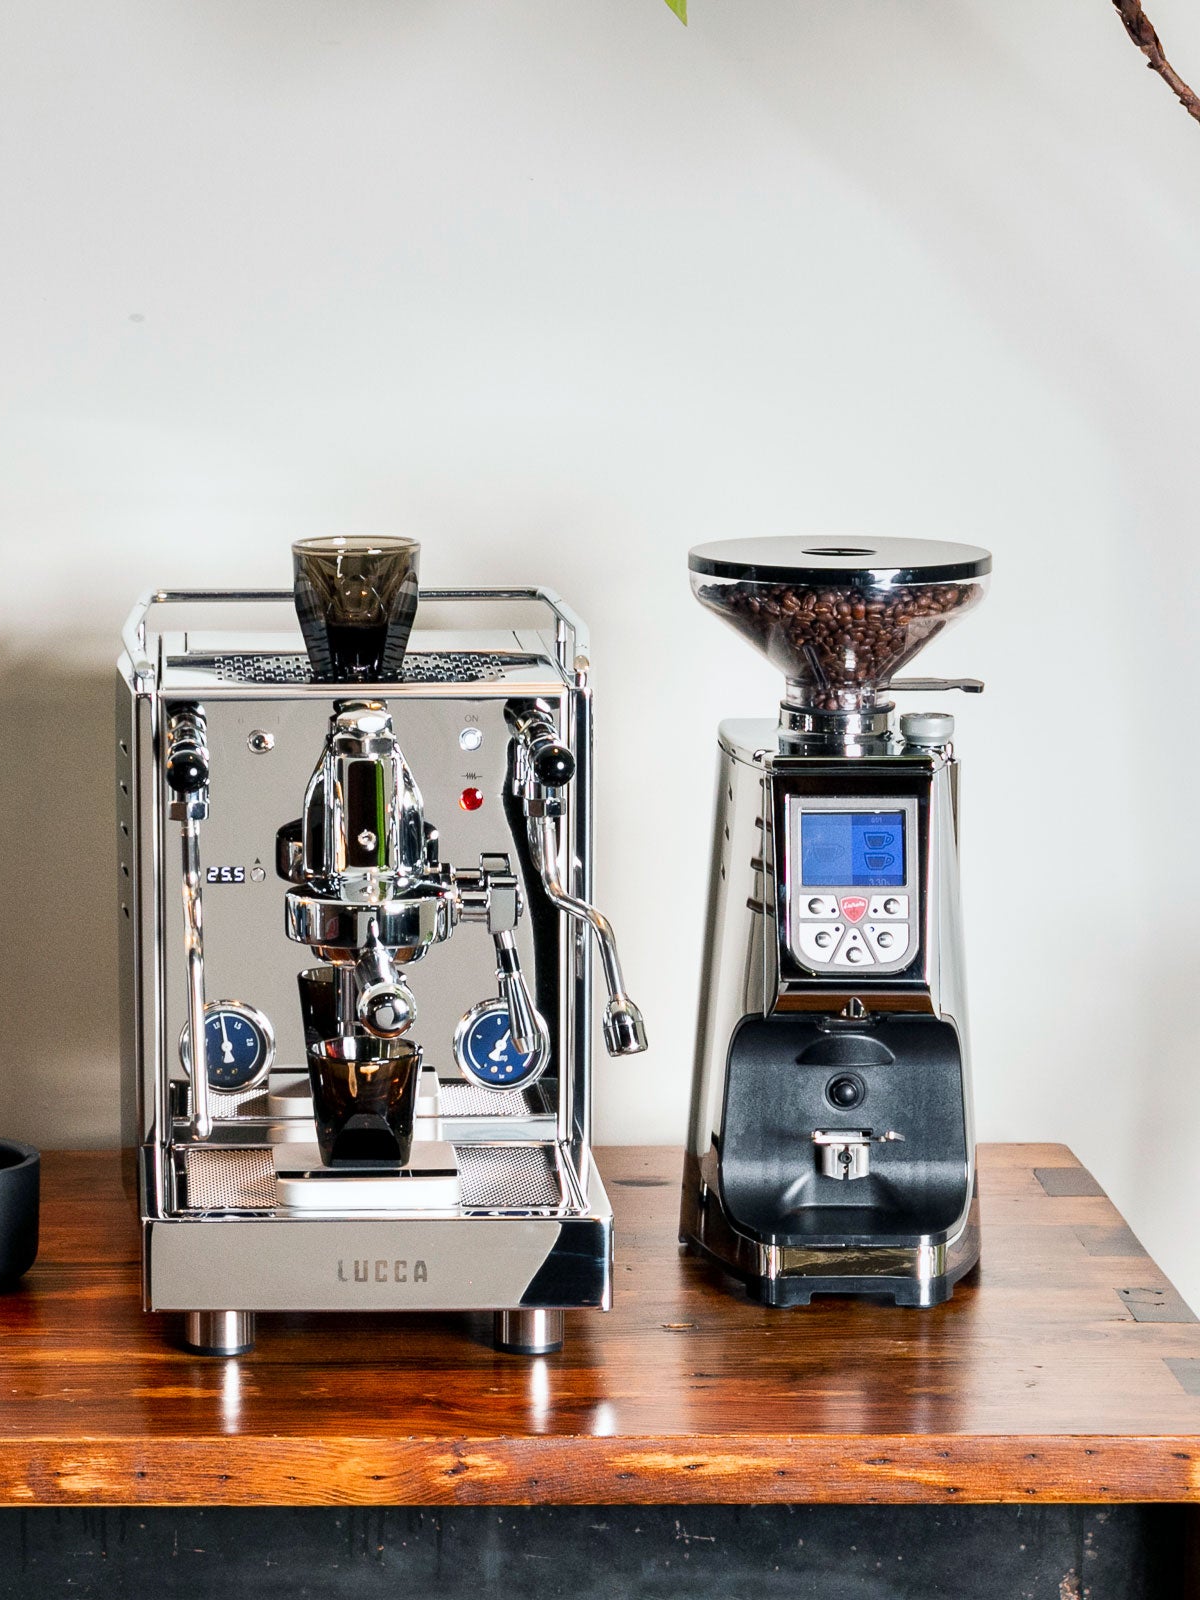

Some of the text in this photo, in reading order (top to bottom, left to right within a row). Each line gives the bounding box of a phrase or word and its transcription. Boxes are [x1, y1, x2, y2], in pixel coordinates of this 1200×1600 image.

[464, 714, 479, 723] ON
[207, 866, 245, 882] 25.5
[338, 1259, 428, 1282] LUCCA
